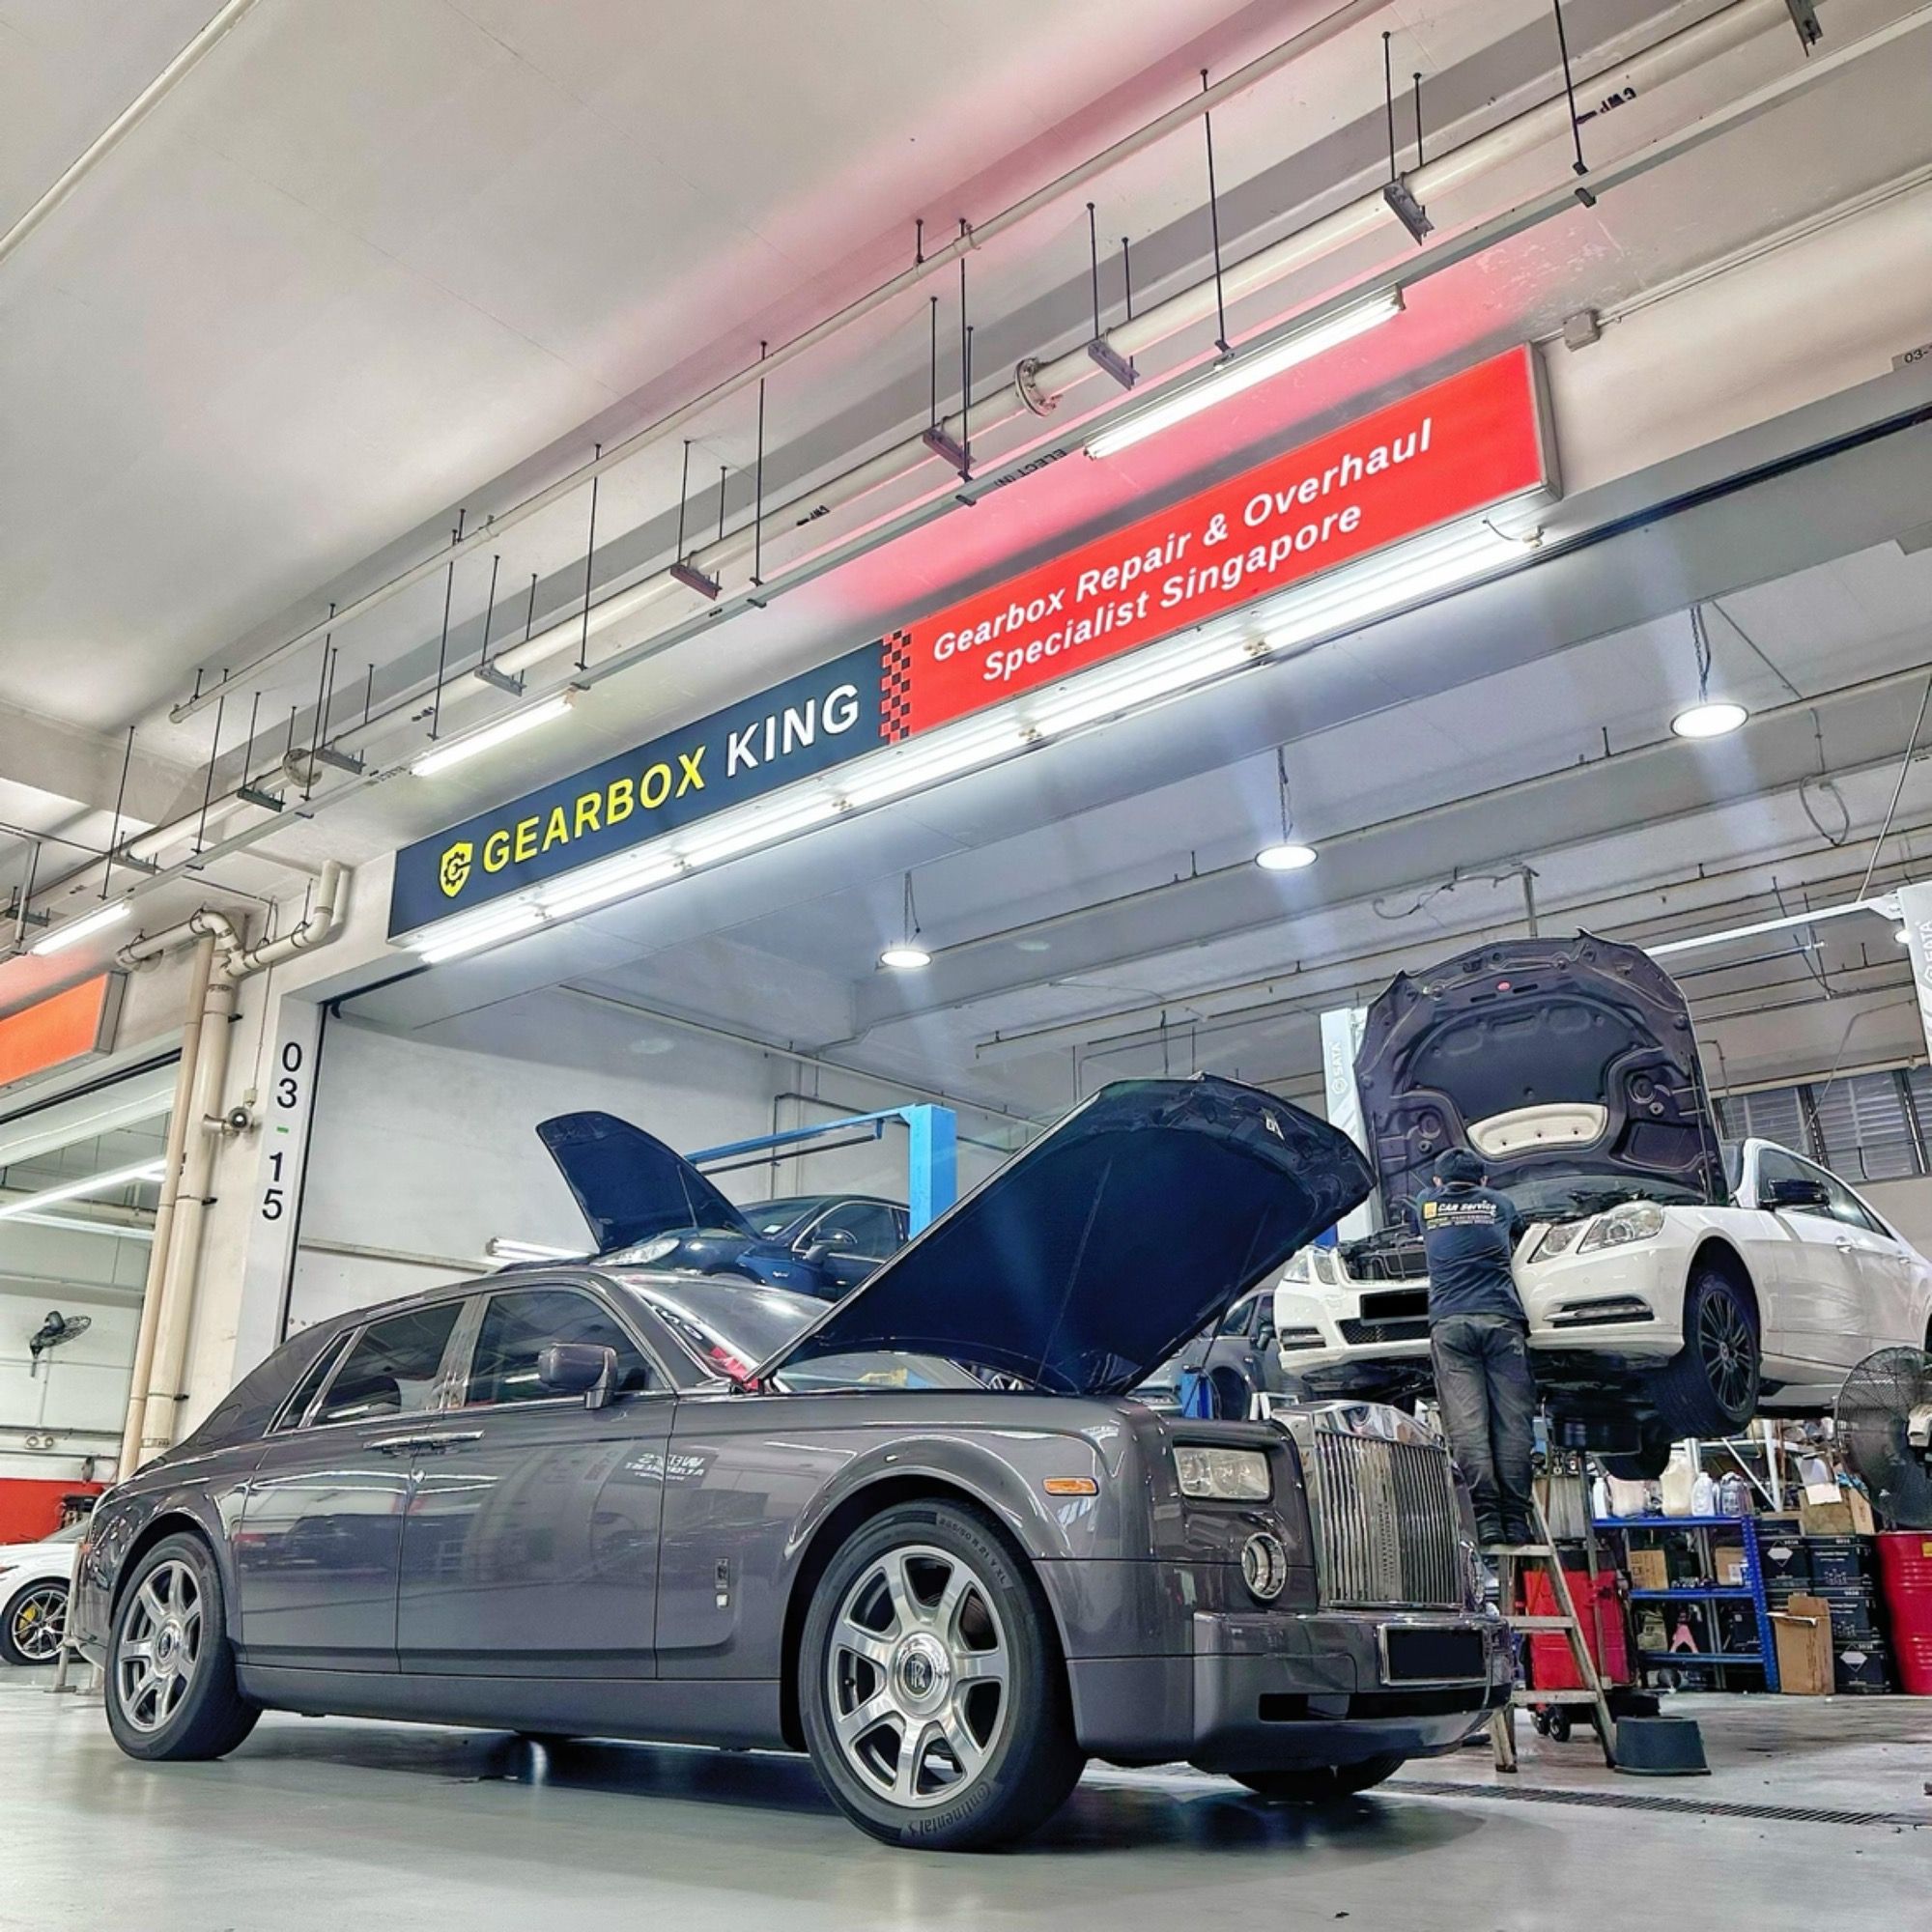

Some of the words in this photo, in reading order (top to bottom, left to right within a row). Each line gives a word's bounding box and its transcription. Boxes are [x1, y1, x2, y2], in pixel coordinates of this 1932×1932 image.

[1904, 344, 1932, 363] 03-
[933, 588, 1065, 661] Gearbox
[1076, 532, 1191, 602] Repair
[1203, 513, 1228, 546] &
[1244, 417, 1432, 526] Overhaul
[983, 590, 1150, 681] Specialist
[1160, 505, 1361, 608] Singapore
[483, 746, 706, 873] GEARBOX
[727, 684, 859, 777] KING
[1329, 1042, 1344, 1079] SATA
[919, 1780, 992, 1836] Continental
